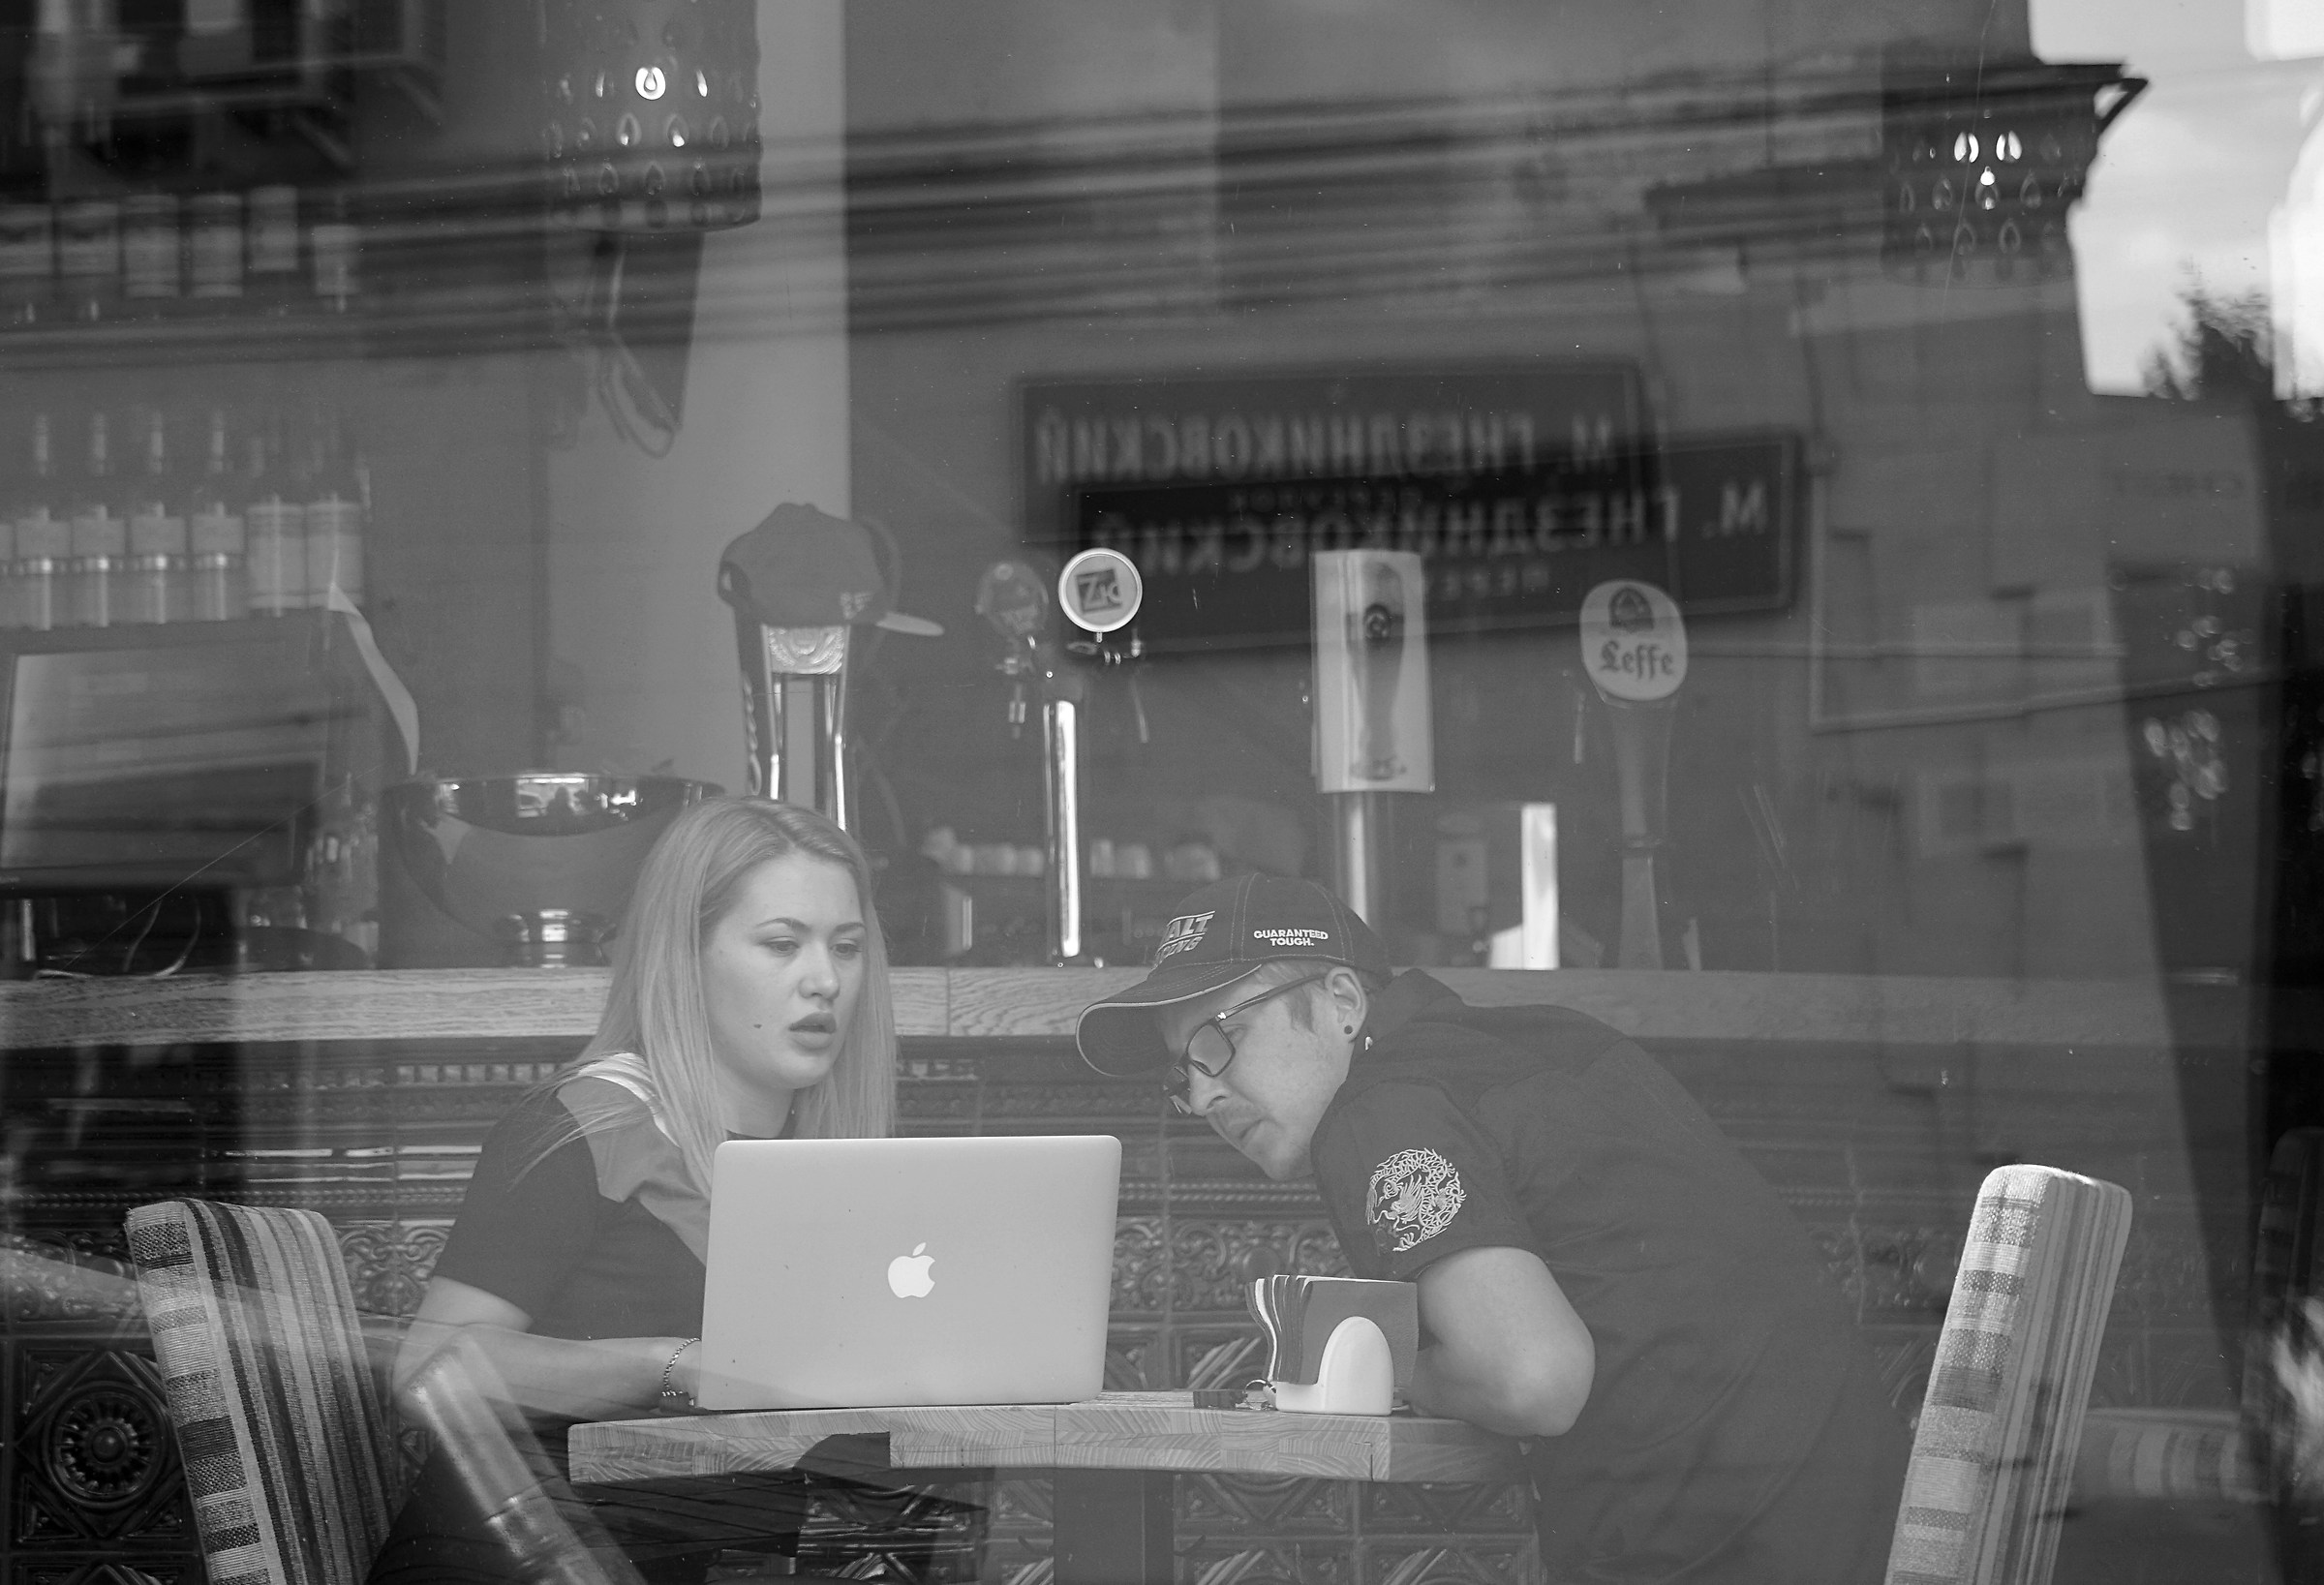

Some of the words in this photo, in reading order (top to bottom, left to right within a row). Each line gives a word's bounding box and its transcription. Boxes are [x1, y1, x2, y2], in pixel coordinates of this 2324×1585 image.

[1601, 640, 1674, 680] Leffe
[1253, 929, 1329, 940] GUARANTEED
[1269, 937, 1315, 947] TOUGH.
